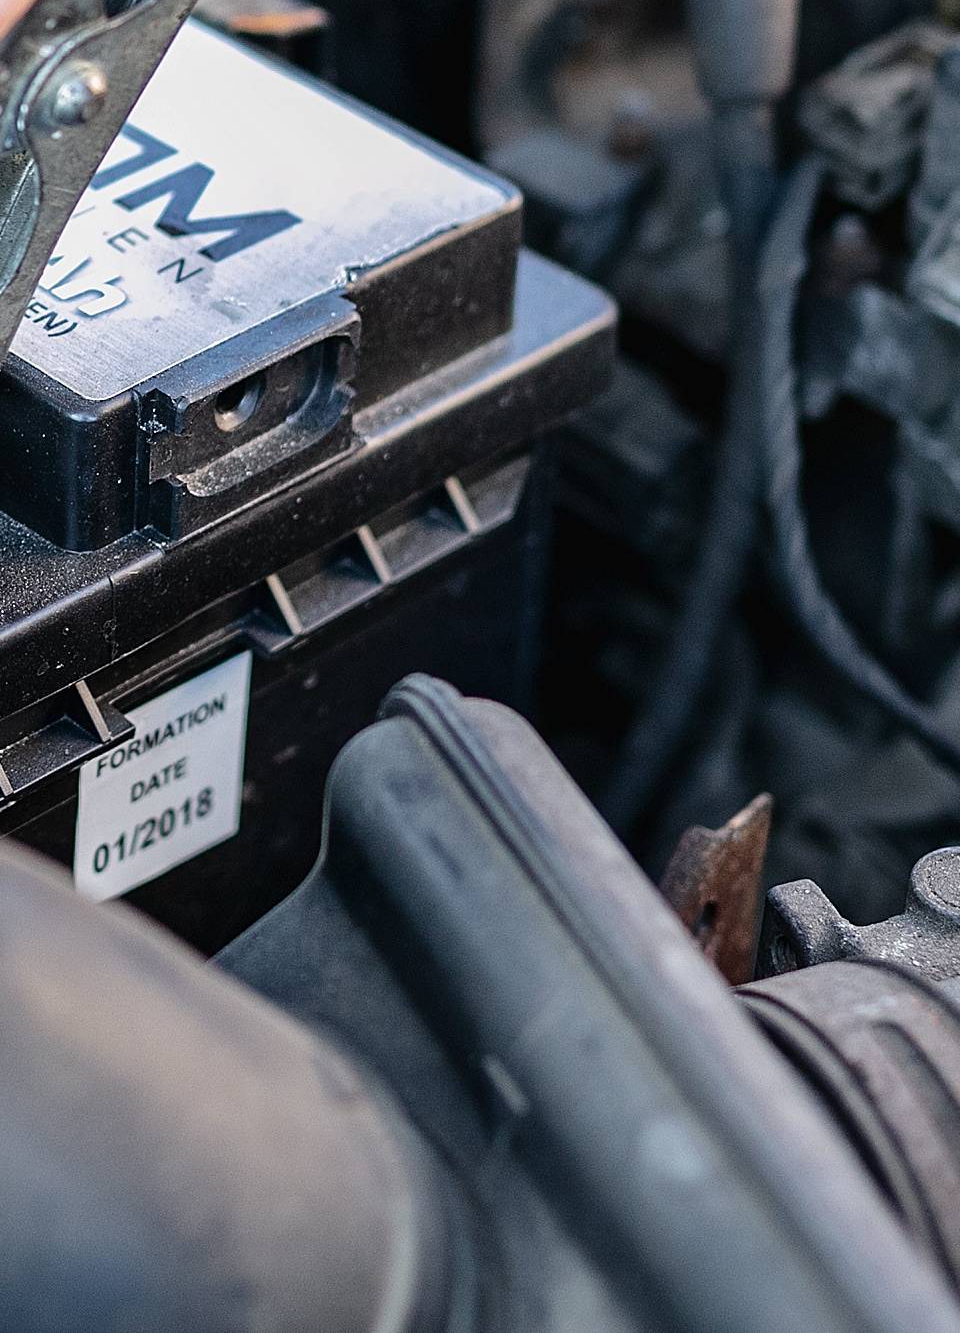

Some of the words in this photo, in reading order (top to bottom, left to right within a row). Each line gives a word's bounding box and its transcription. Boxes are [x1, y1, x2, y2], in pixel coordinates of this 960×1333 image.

[95, 692, 228, 778] FORMATION
[129, 756, 188, 804] DATE
[91, 786, 215, 875] 01/2018
